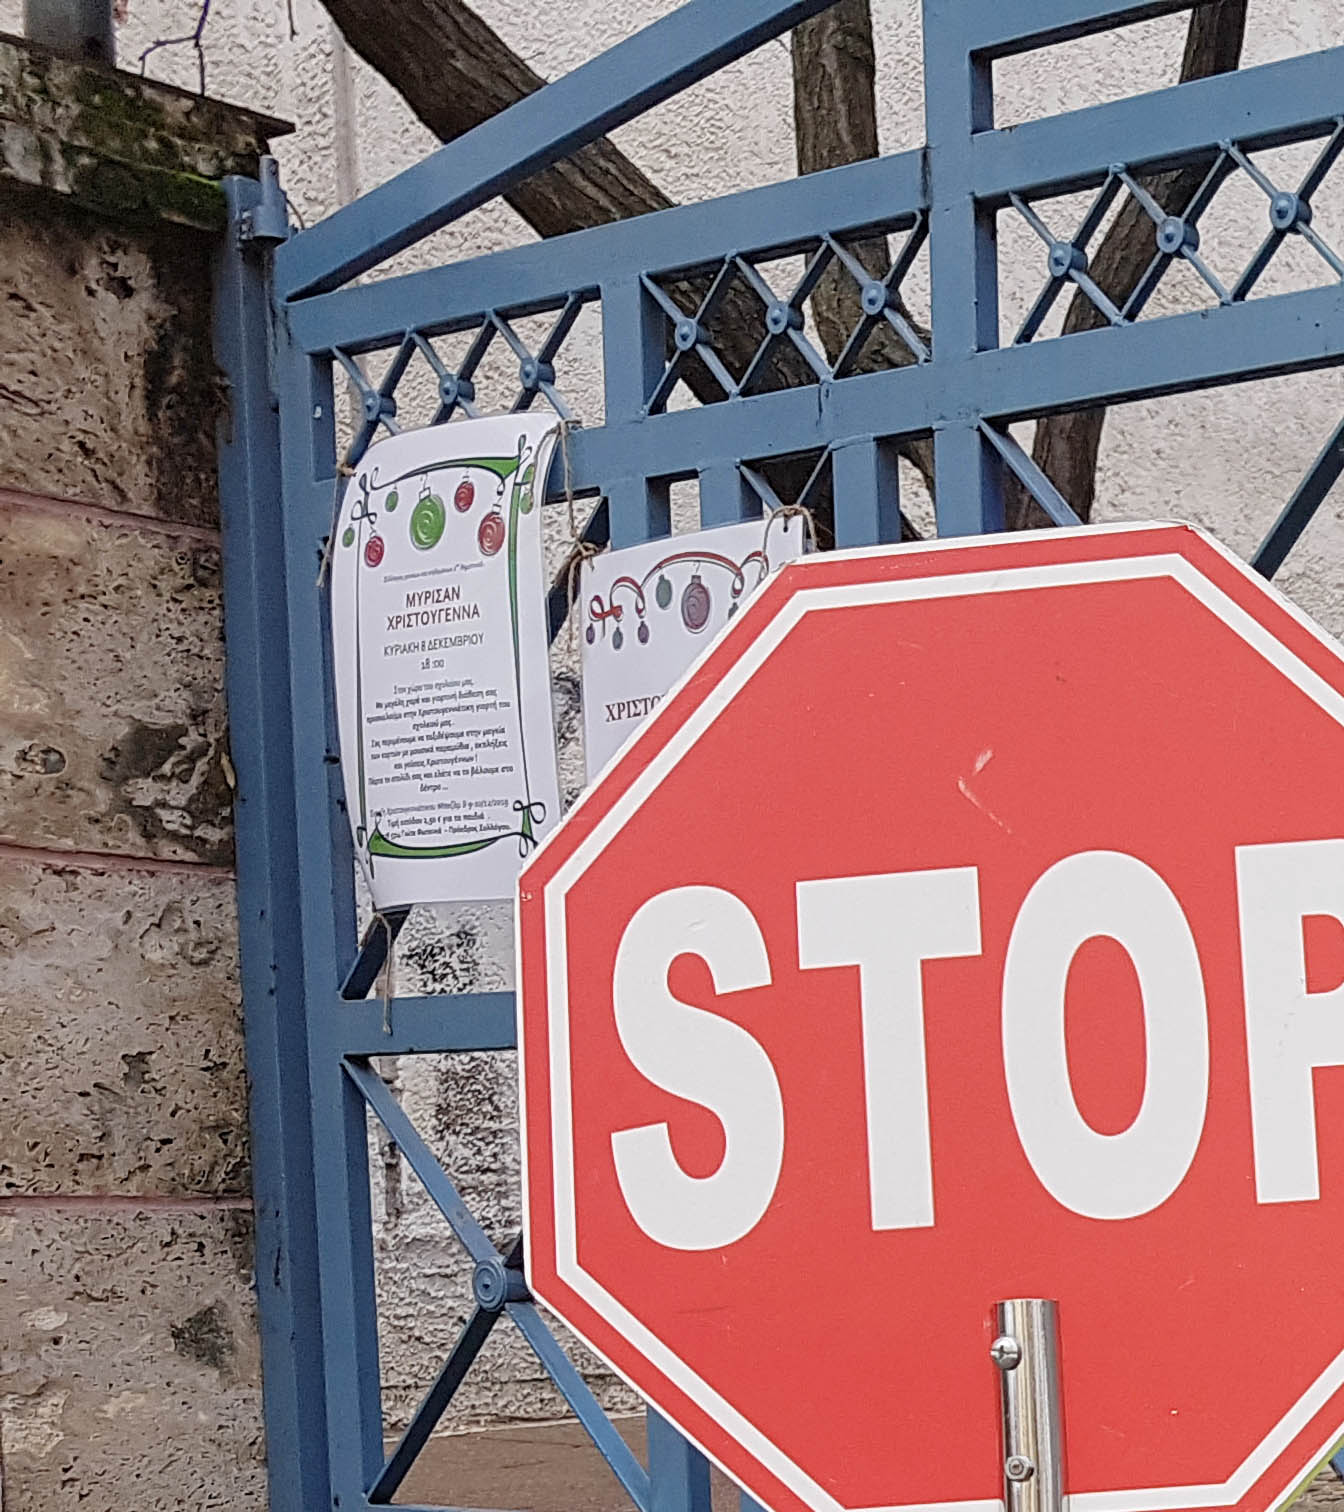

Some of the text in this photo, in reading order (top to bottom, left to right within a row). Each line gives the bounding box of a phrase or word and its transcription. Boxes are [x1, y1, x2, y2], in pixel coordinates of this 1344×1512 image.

[406, 585, 461, 608] ΜΥΡΙΣΑΝ
[387, 604, 480, 631] ΧΡΙΣΤΟΥΓΕΝΝΑ
[384, 641, 420, 656] ΚΥΡΙΑΚΗ
[428, 633, 484, 651] ΔΕΚΕΜΒΡΙΟΥ
